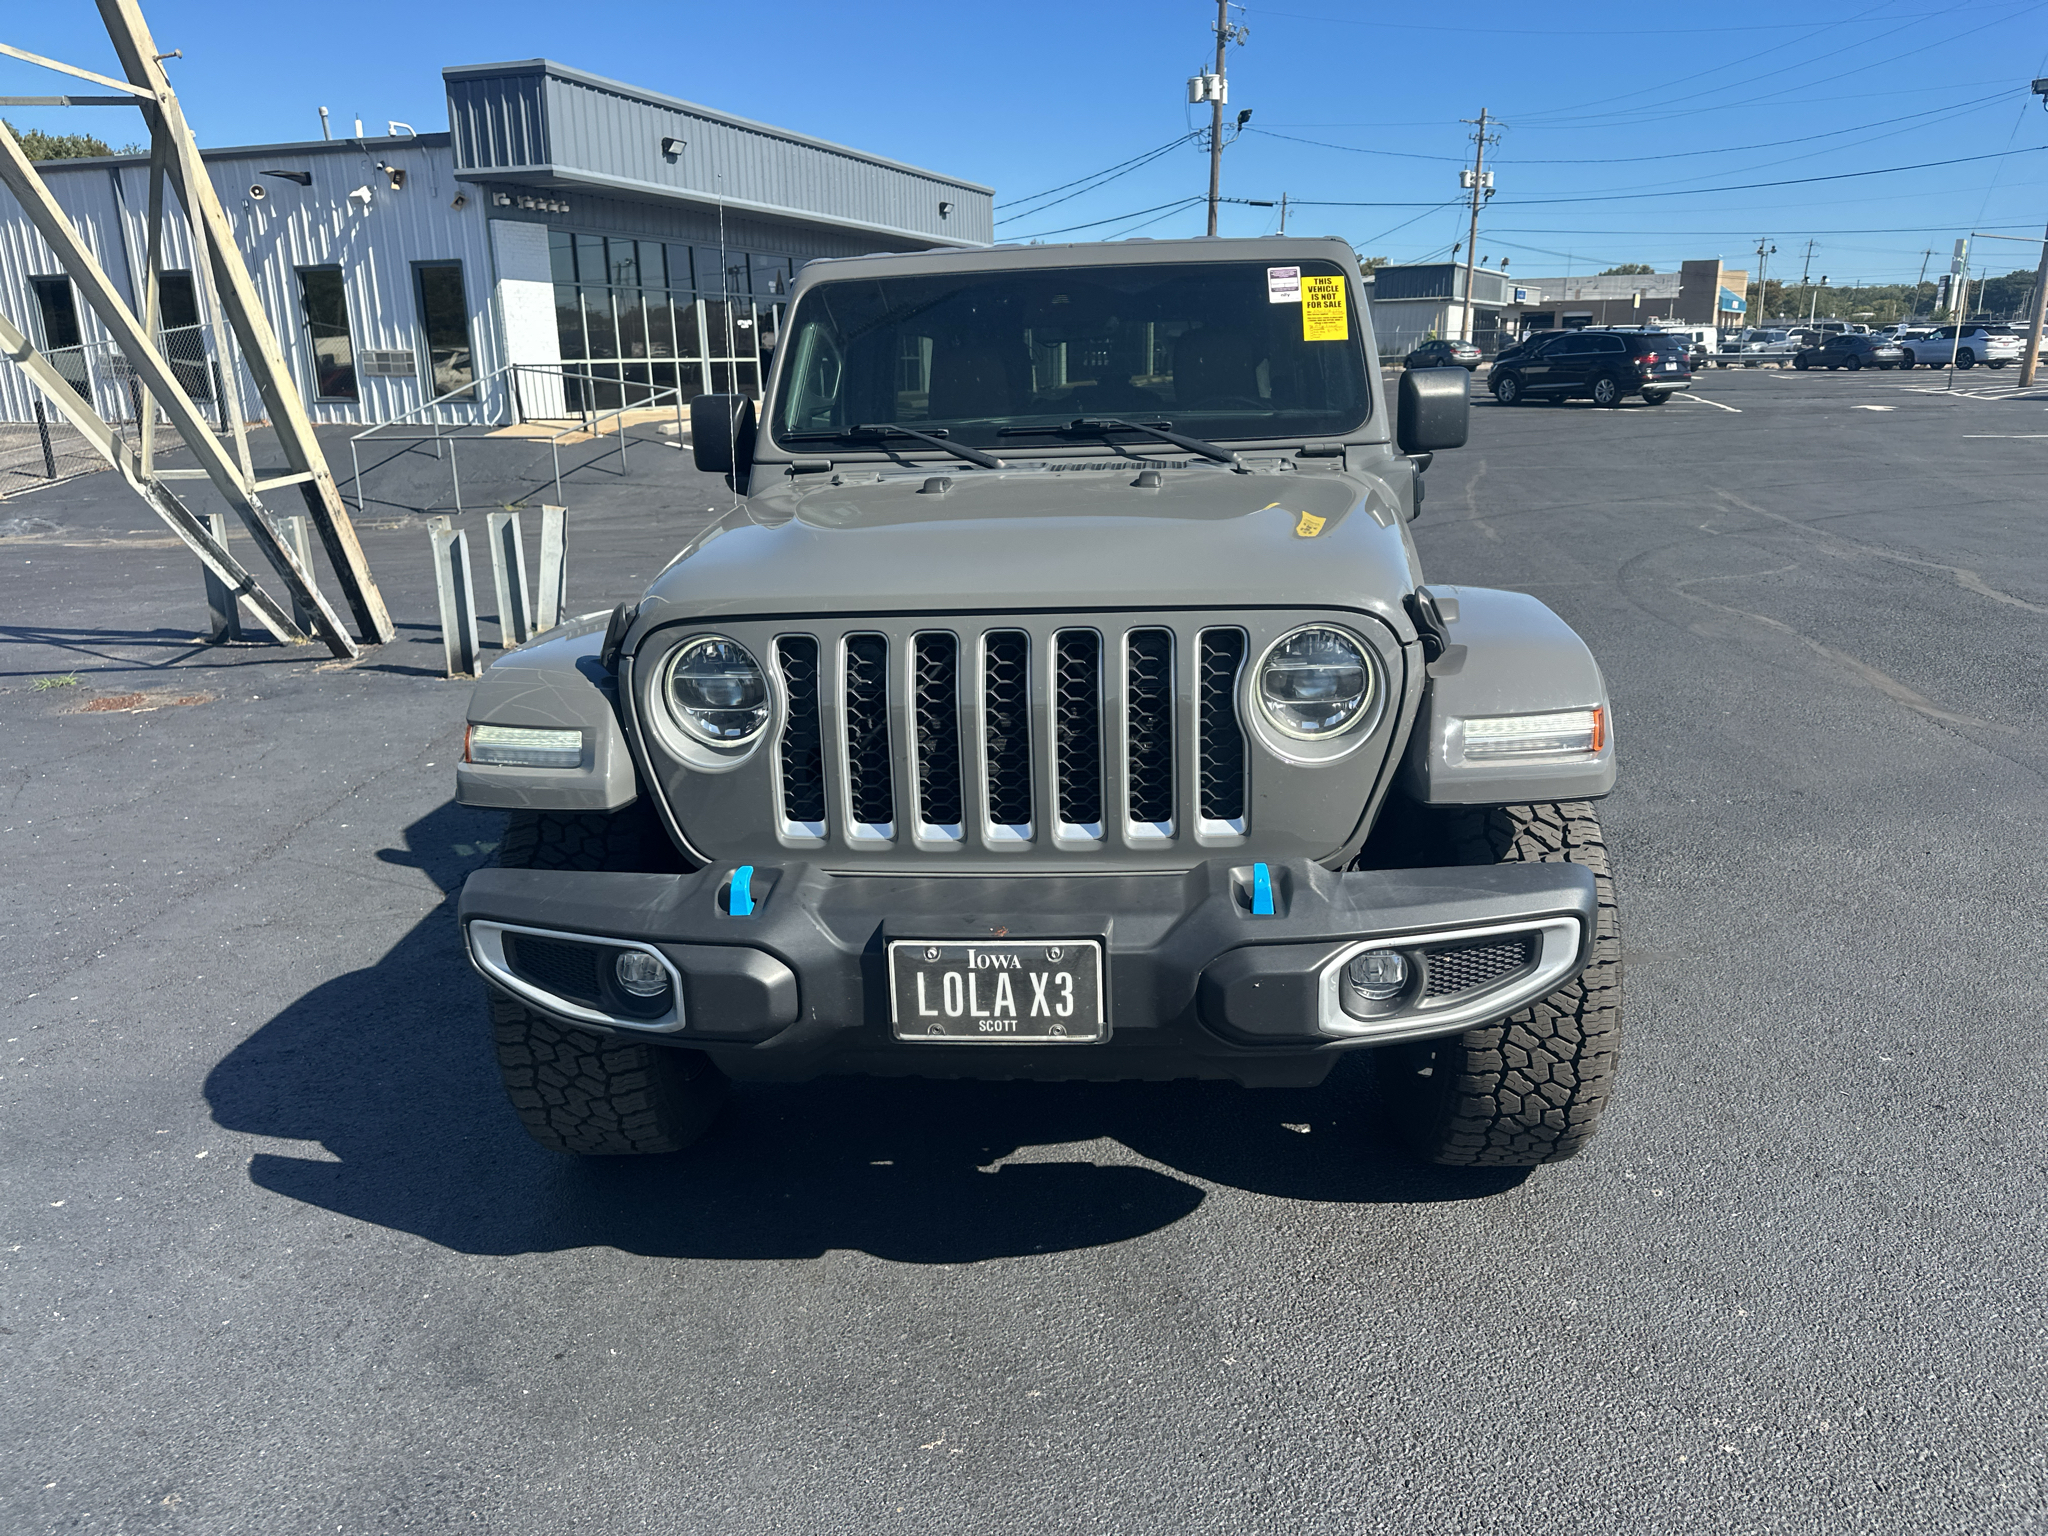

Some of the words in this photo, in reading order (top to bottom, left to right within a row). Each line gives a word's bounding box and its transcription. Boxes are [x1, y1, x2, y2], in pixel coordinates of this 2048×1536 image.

[1313, 277, 1332, 285] THIS
[1307, 285, 1339, 293] VEHICLE
[1307, 301, 1322, 309] FOR
[1323, 300, 1342, 308] SALE
[916, 972, 1017, 1017] LOLA
[1029, 972, 1074, 1017] X3
[979, 1020, 1018, 1032] SCOTT
